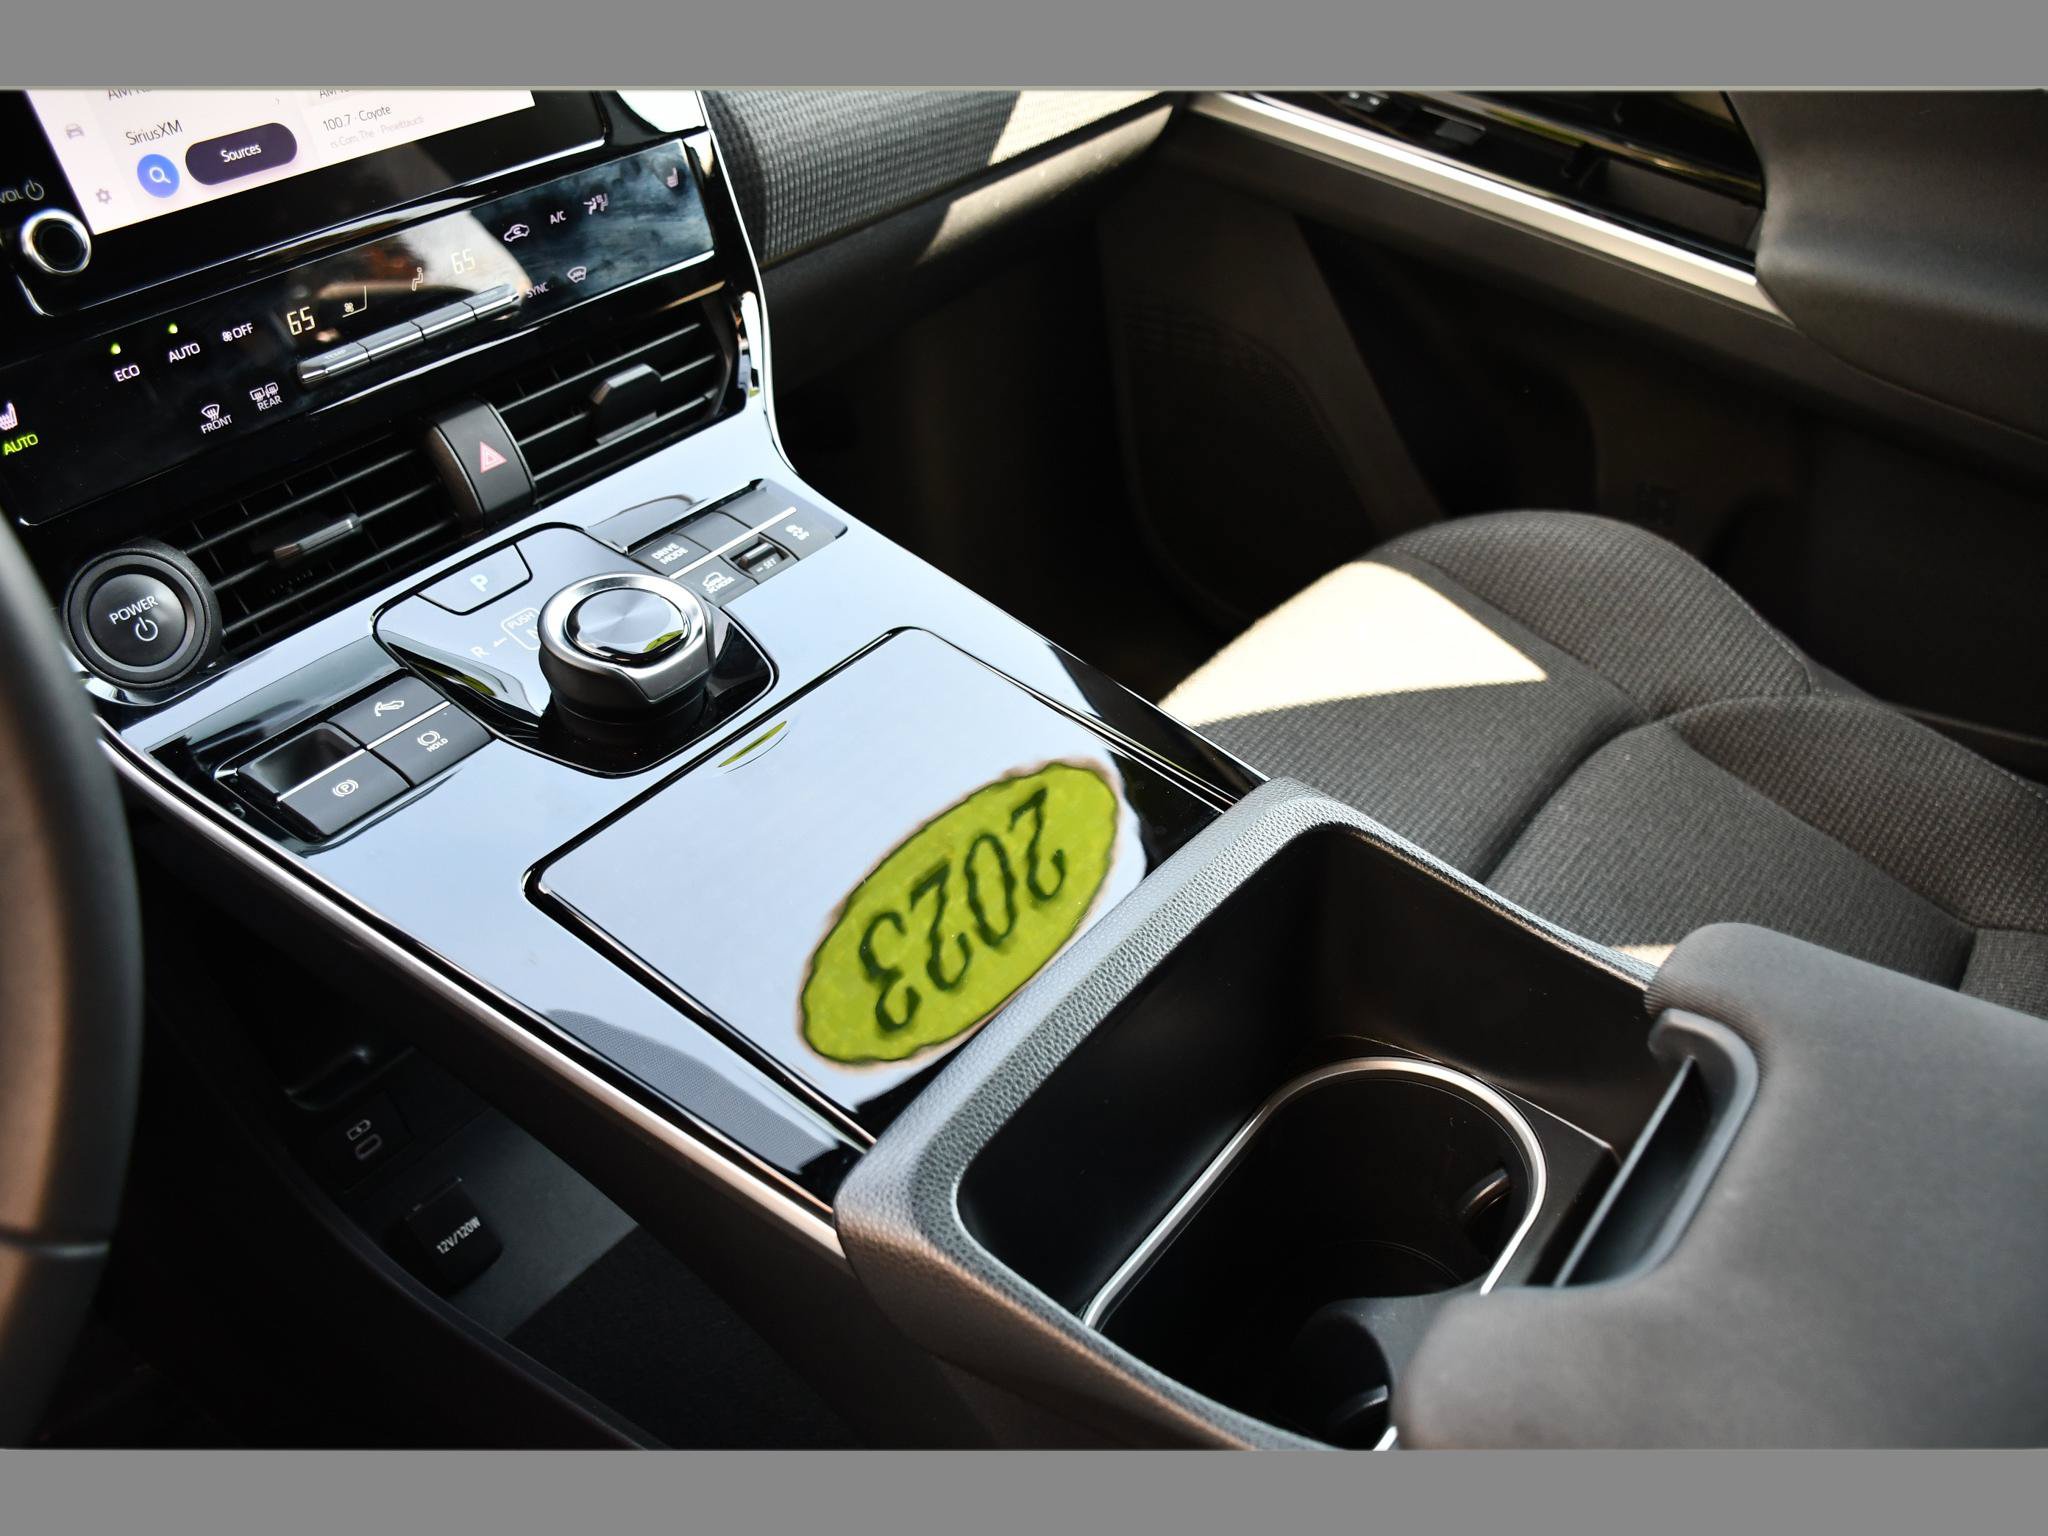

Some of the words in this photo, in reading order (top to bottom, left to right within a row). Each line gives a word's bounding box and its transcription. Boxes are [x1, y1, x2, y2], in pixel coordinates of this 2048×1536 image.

[125, 119, 183, 146] SiriusXM
[220, 143, 262, 163] Sources
[549, 210, 567, 225] A/C
[450, 248, 476, 274] 65
[525, 282, 550, 299] SYNC
[233, 323, 254, 339] OFF
[286, 306, 316, 336] 65
[168, 342, 201, 363] AUTO
[114, 364, 141, 383] ECO
[256, 394, 283, 412] REAR
[200, 414, 233, 434] FRONT
[2, 433, 39, 455] AUTO
[469, 574, 489, 593] P
[108, 595, 159, 625] POWER
[506, 610, 536, 630] PUSH
[470, 645, 490, 659] R
[426, 737, 449, 753] HOLD
[857, 785, 1067, 1034] 2023
[436, 1215, 482, 1255] 12V/120W
